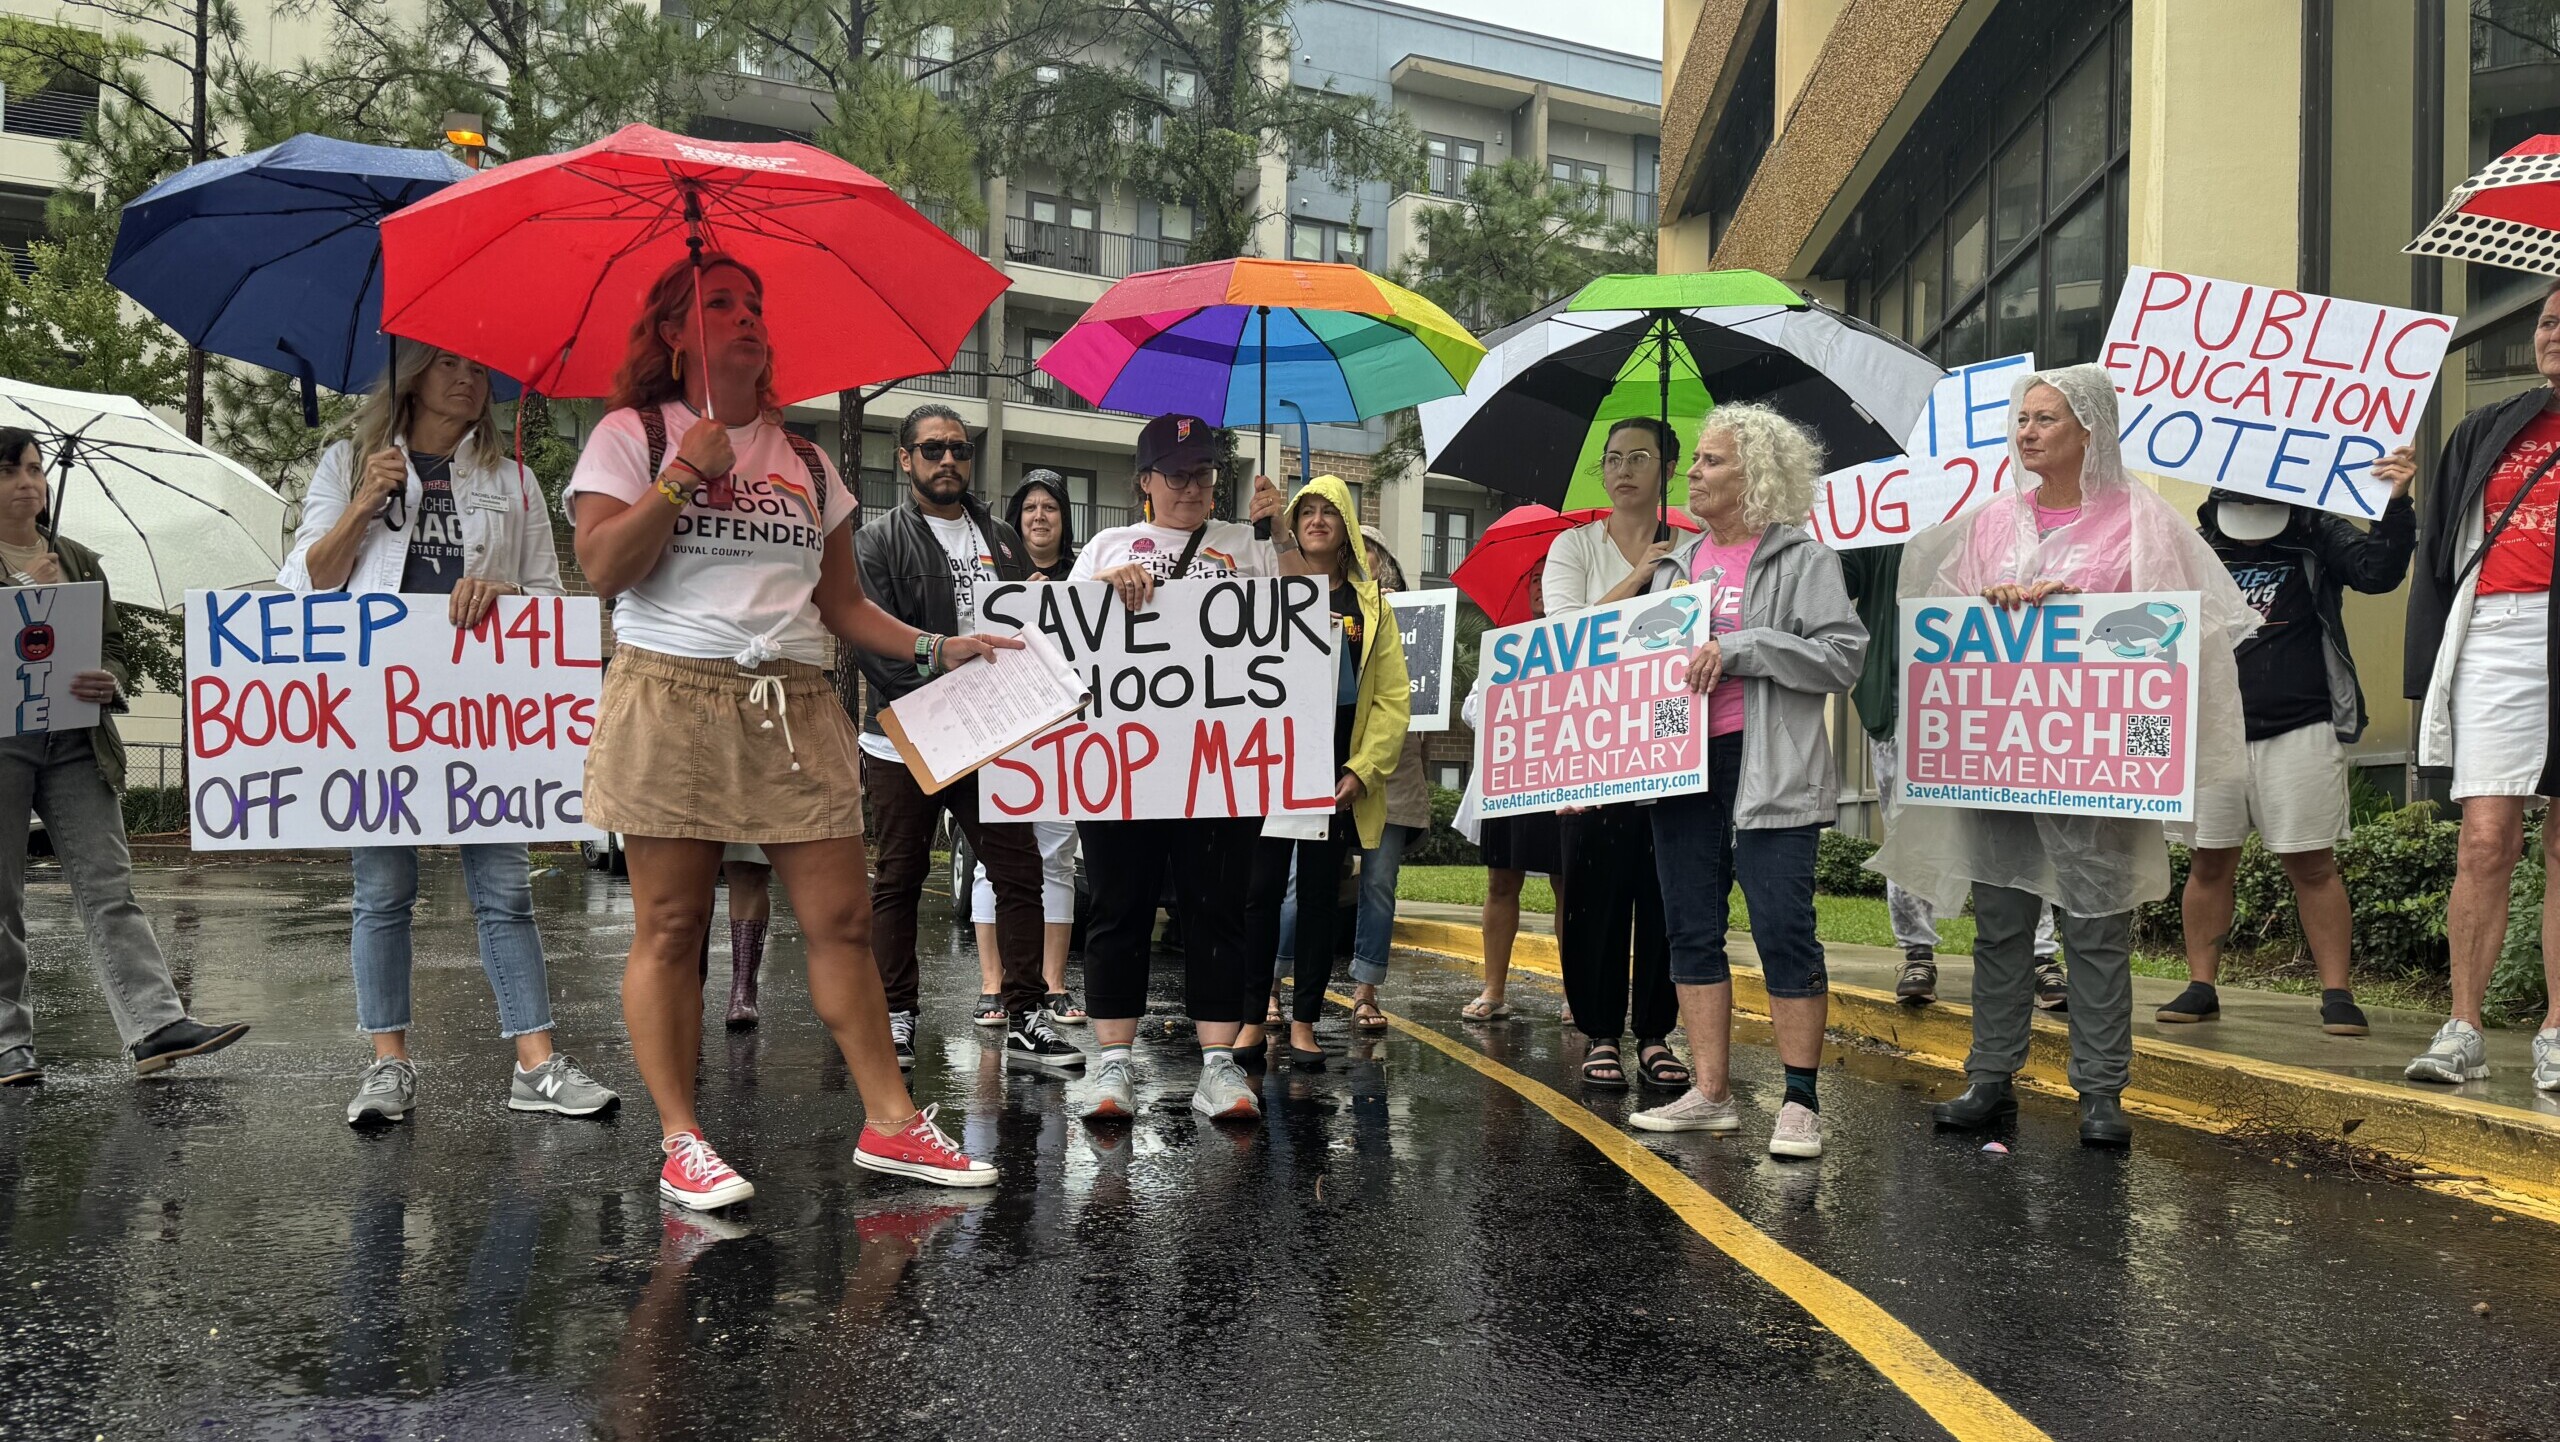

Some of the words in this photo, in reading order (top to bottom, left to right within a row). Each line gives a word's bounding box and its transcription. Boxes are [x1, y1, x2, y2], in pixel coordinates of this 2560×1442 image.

[2131, 272, 2450, 380] PUBLIC
[2105, 342, 2416, 435] EDUCATION
[410, 545, 442, 555] STATE
[673, 515, 822, 551] DEFENDERS
[673, 545, 708, 555] DUVAL
[711, 547, 754, 558] COUNTY
[206, 591, 408, 667] KEEP
[451, 597, 602, 668] M4L
[982, 580, 1171, 661] SAVE
[1199, 576, 1332, 655] OUR
[1491, 610, 1622, 684] SAVE
[1913, 605, 2083, 664] SAVE
[14, 588, 57, 736] VOTE
[1077, 655, 1286, 720] HOOLS
[1494, 654, 1689, 722] ATLANTIC
[1920, 667, 2172, 710] ATLANTIC
[191, 672, 357, 759] BOOK
[384, 665, 595, 752] Banners
[1492, 701, 1649, 764] BEACH
[1918, 709, 2121, 756] BEACH
[991, 722, 1160, 820] STOP
[1184, 716, 1337, 818] M4L
[1482, 772, 1701, 812] SaveAtlanticBeachElementary.com
[1491, 739, 1690, 791] ELEMENTARY
[1918, 752, 2170, 789] ELEMENTARY
[196, 766, 303, 840] OFF
[320, 765, 423, 836] OUR
[1906, 783, 2182, 814] SaveAtlanticBeachElementary.com
